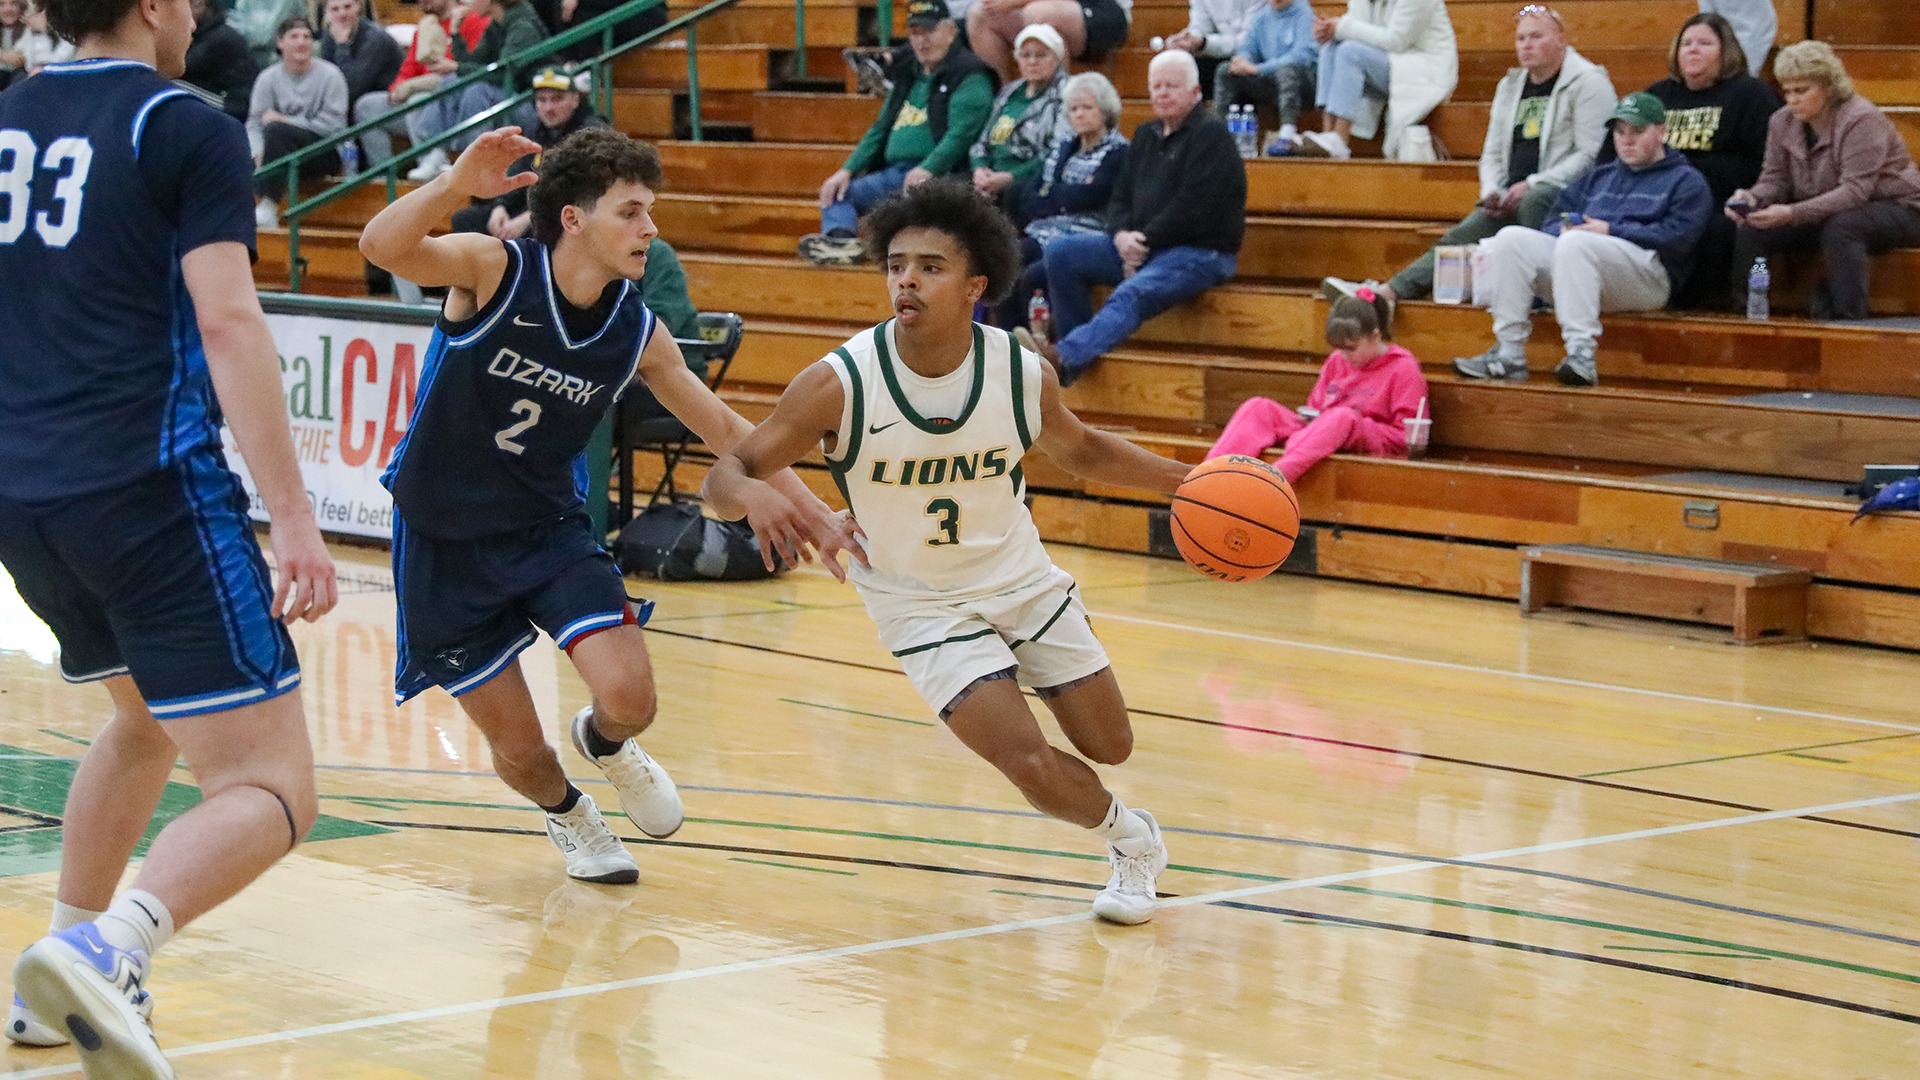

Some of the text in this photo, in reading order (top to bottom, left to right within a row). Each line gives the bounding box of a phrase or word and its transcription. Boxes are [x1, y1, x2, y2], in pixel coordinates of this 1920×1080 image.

[488, 348, 605, 405] OZARK
[495, 398, 541, 455] 2
[870, 446, 1010, 487] LIONS
[320, 498, 353, 521] feel
[924, 496, 962, 546] 3
